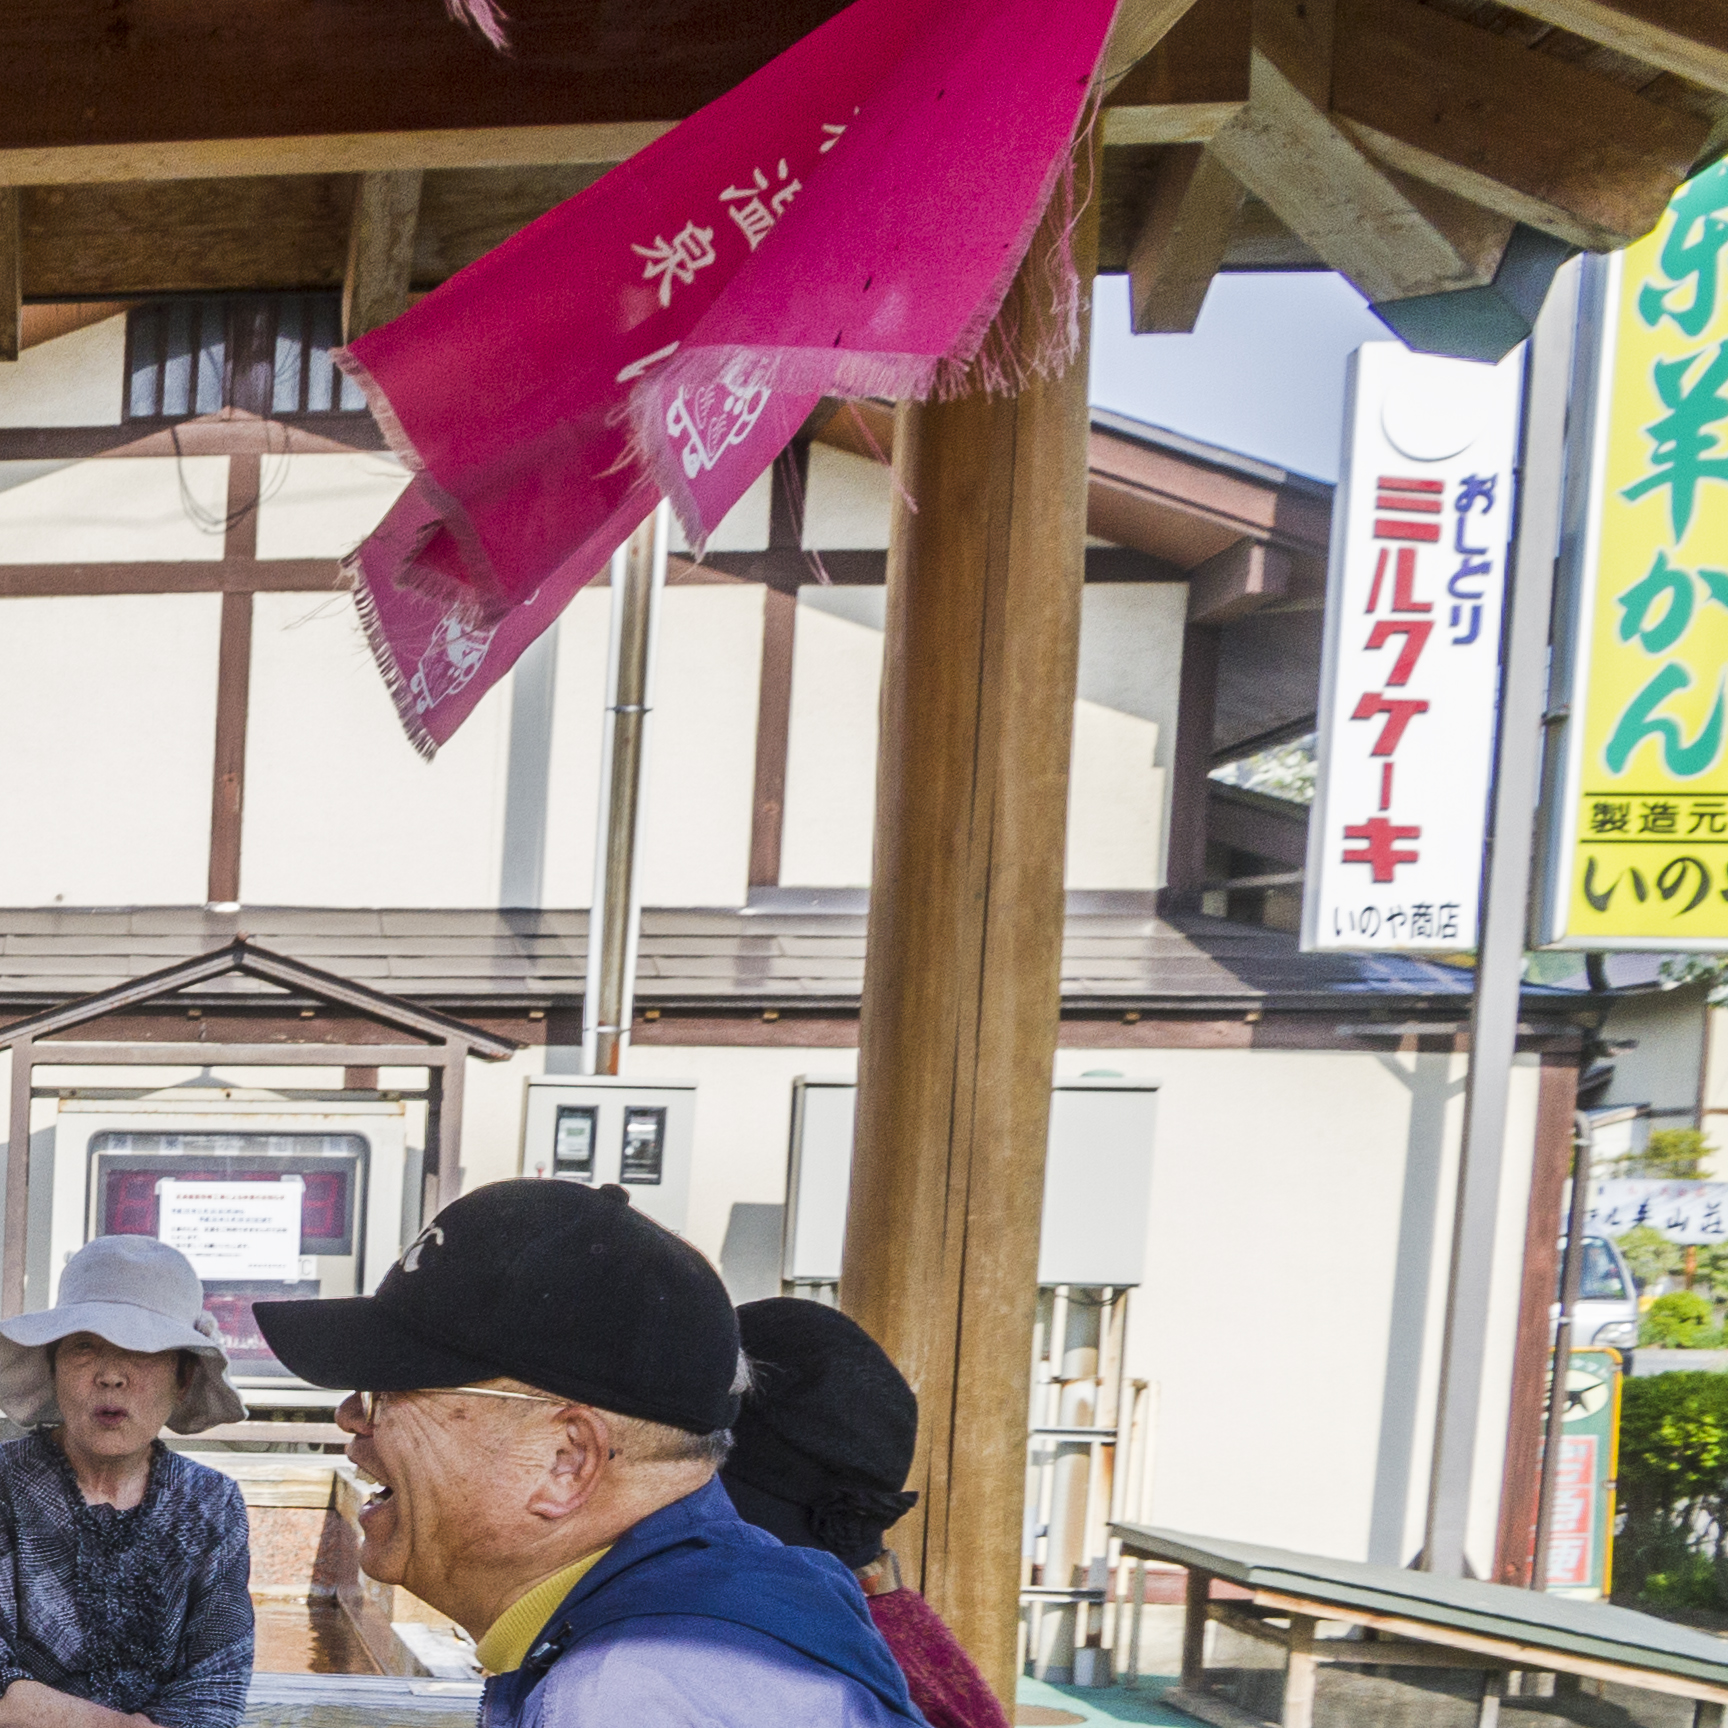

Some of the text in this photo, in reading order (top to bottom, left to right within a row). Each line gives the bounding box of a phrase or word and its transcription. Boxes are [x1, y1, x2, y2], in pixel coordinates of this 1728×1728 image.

[1446, 472, 1498, 646] おしどり
[1341, 474, 1446, 884] ミルクケーキ
[1589, 800, 1727, 834] 製造元
[1583, 854, 1728, 919] いの
[1332, 901, 1461, 939] いのや商店
